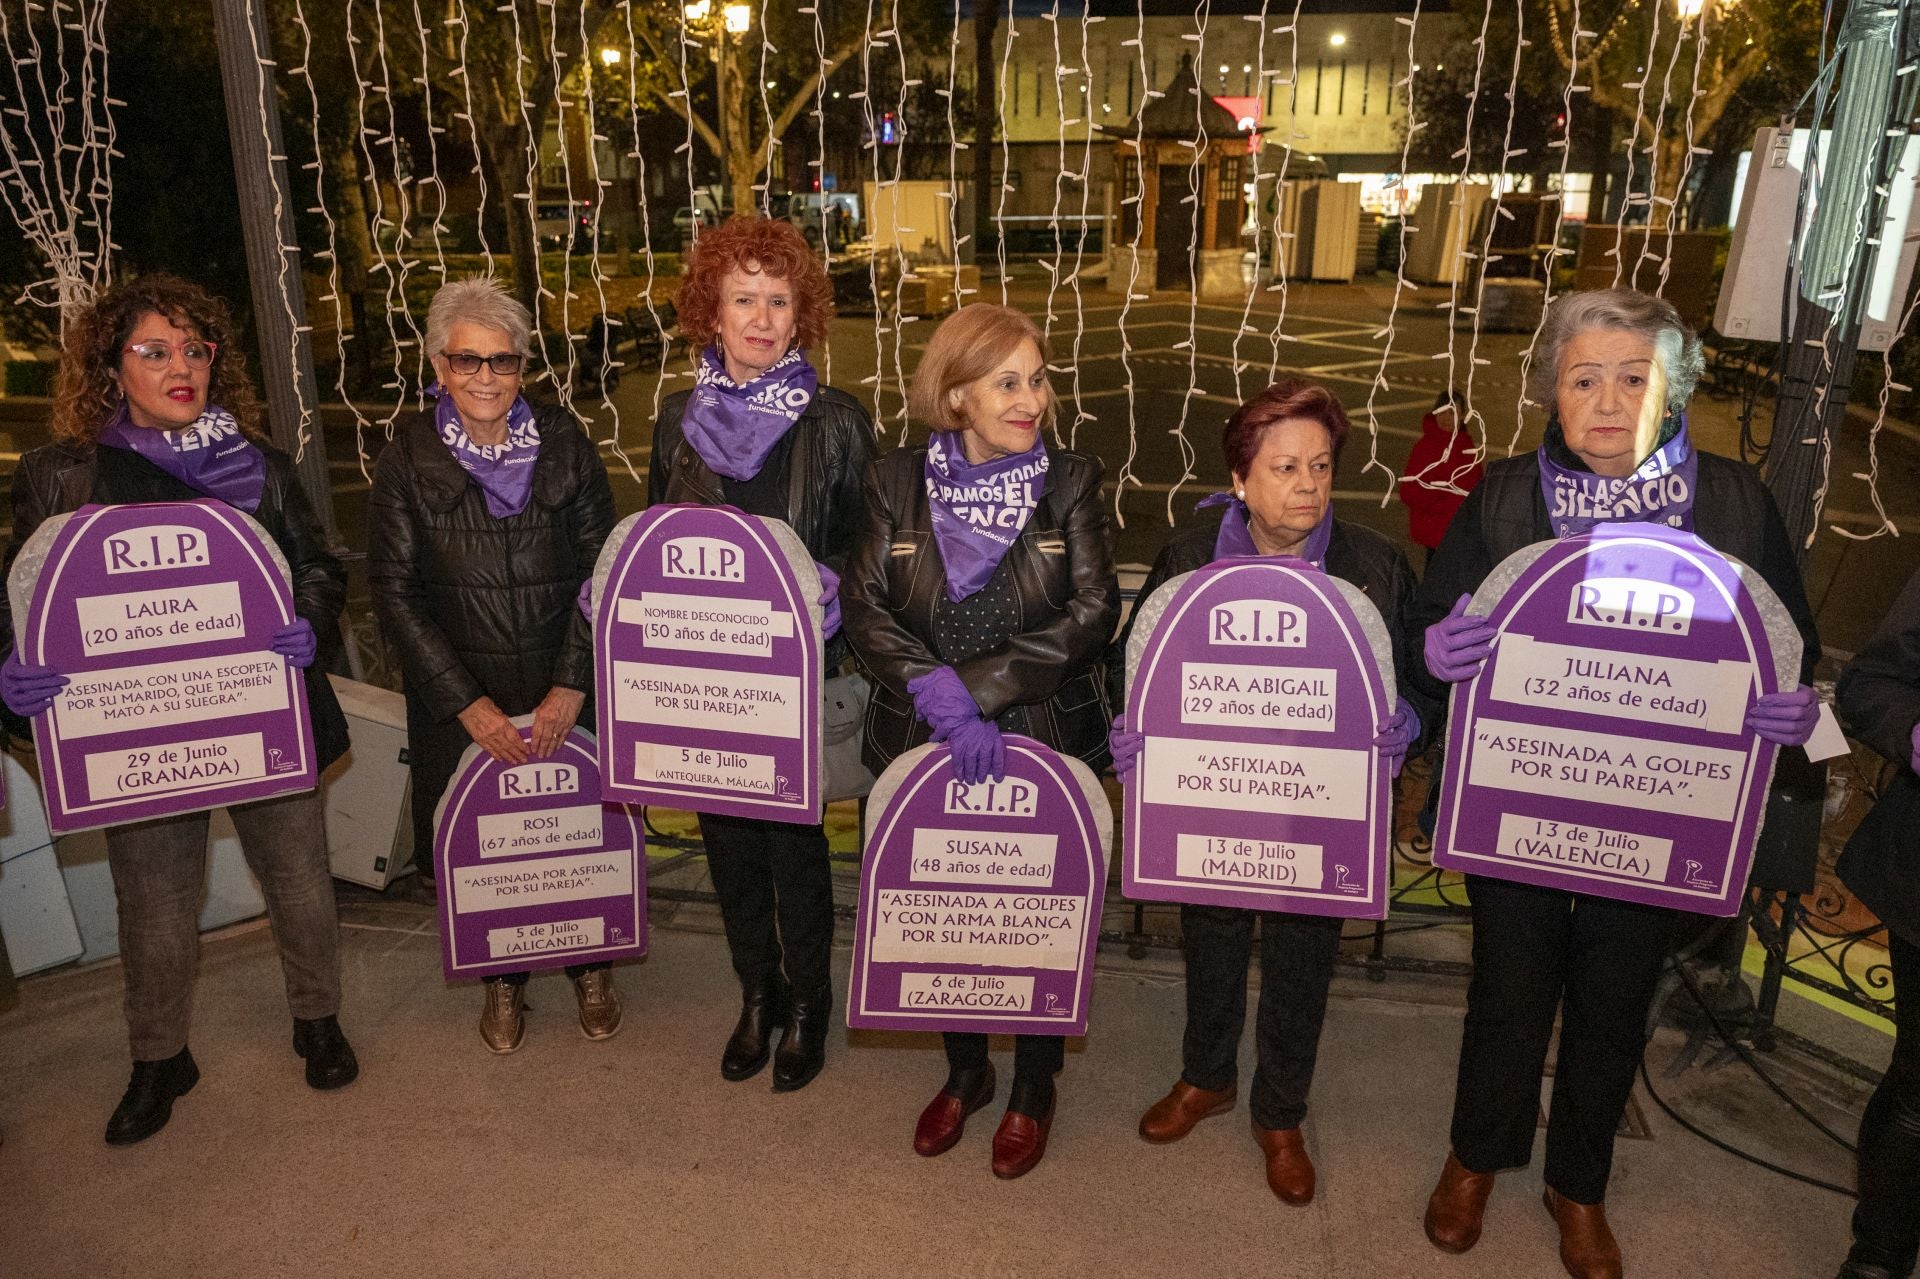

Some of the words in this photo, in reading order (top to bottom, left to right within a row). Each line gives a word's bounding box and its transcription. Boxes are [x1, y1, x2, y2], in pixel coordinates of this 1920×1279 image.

[749, 404, 785, 416] fundación
[1005, 482, 1038, 508] EL
[971, 526, 1009, 546] fundación
[109, 533, 204, 570] R.I.P.
[667, 544, 740, 578] R.I.P.
[126, 598, 198, 619] LAURA
[645, 608, 688, 619] NOMBRE
[692, 612, 768, 625] DESCONOCIDO
[1574, 584, 1682, 631] R.I.P.
[85, 628, 117, 647] (20
[125, 626, 163, 639] años
[170, 621, 188, 634] de
[196, 613, 241, 631] edad)
[645, 624, 669, 639] (50
[675, 627, 704, 640] años
[710, 629, 725, 642] de
[732, 631, 769, 648] edad)
[1215, 610, 1300, 643] R.I.P.
[148, 674, 177, 686] CON
[182, 671, 212, 682] UNA
[217, 662, 277, 678] ESCOPETA
[1563, 658, 1672, 688] JULIANA
[68, 699, 95, 710] POR
[100, 696, 116, 706] SU
[122, 687, 180, 704] MARIDO,
[185, 683, 213, 696] QUE
[217, 674, 271, 692] TAMBIÉN
[625, 679, 700, 695] “ASESINADA
[705, 686, 728, 697] POR
[733, 689, 785, 704] ASFIXIA,
[1189, 675, 1240, 692] SARA
[1247, 678, 1328, 696] ABIGAIL
[103, 704, 144, 719] MATÓ
[150, 704, 160, 713] A
[164, 698, 180, 711] SU
[185, 691, 247, 708] SUEGRA”.
[656, 696, 679, 708] POR
[684, 699, 698, 710] SU
[704, 701, 757, 716] PAREJA”.
[1184, 697, 1212, 714] (29
[1220, 698, 1254, 715] años
[1262, 702, 1280, 716] de
[1287, 703, 1332, 722] edad)
[1525, 678, 1559, 696] (32
[1567, 686, 1611, 702] años
[1619, 691, 1642, 707] de
[1650, 696, 1706, 718] edad)
[128, 753, 150, 768] 29
[158, 750, 177, 763] de
[184, 744, 228, 764] Junio
[682, 749, 689, 762] 5
[696, 751, 711, 764] de
[717, 753, 747, 768] Julio
[1197, 755, 1305, 777] “ASFIXIADA
[1479, 734, 1611, 765] “ASESINADA
[1620, 753, 1637, 768] A
[1646, 756, 1731, 780] GOLPES
[118, 758, 241, 792] (GRANADA)
[503, 768, 575, 796] R.I.P.
[655, 770, 723, 785] (ANTEQUERA.
[726, 774, 773, 792] MÁLAGA)
[1511, 759, 1552, 778] POR
[1560, 766, 1587, 783] SU
[1595, 769, 1693, 797] PAREJA”.
[950, 782, 1030, 813] R.I.P.
[1178, 775, 1212, 791] POR
[1220, 778, 1241, 793] SU
[1249, 780, 1330, 800] PAREJA”.
[524, 817, 558, 830] ROSI
[482, 838, 505, 851] (67
[512, 833, 540, 846] años
[546, 833, 560, 843] de
[566, 828, 600, 841] edad)
[946, 840, 1022, 856] SUSANA
[1536, 822, 1558, 837] 13
[1567, 824, 1588, 842] de
[1595, 829, 1640, 851] Julio
[1208, 839, 1226, 854] 13
[1234, 842, 1251, 856] de
[1259, 843, 1295, 859] Julio
[1514, 837, 1650, 877] (VALENCIA)
[465, 873, 539, 887] “ASESINADA
[544, 869, 566, 880] POR
[571, 864, 618, 876] ASFIXIA,
[914, 859, 940, 873] (48
[947, 862, 980, 873] años
[987, 862, 1004, 874] de
[1010, 864, 1051, 879] edad)
[1201, 859, 1296, 884] (MADRID)
[496, 886, 519, 896] POR
[524, 883, 538, 892] SU
[543, 877, 594, 890] PAREJA”.
[882, 894, 987, 908] “ASESINADA
[994, 898, 1006, 909] A
[1013, 898, 1076, 911] GOLPES
[517, 928, 524, 937] 5
[530, 927, 544, 936] de
[551, 923, 579, 935] Julio
[883, 911, 892, 923] Y
[898, 912, 936, 924] CON
[943, 914, 995, 926] ARMA
[1003, 915, 1071, 929] BLANCA
[506, 934, 589, 954] (ALICANTE)
[903, 930, 935, 942] POR
[941, 931, 962, 943] SU
[970, 932, 1052, 946] MARIDO”.
[932, 976, 941, 987] 6
[948, 976, 965, 988] de
[971, 977, 1004, 990] Julio
[908, 992, 1026, 1010] (ZARAGOZA)
